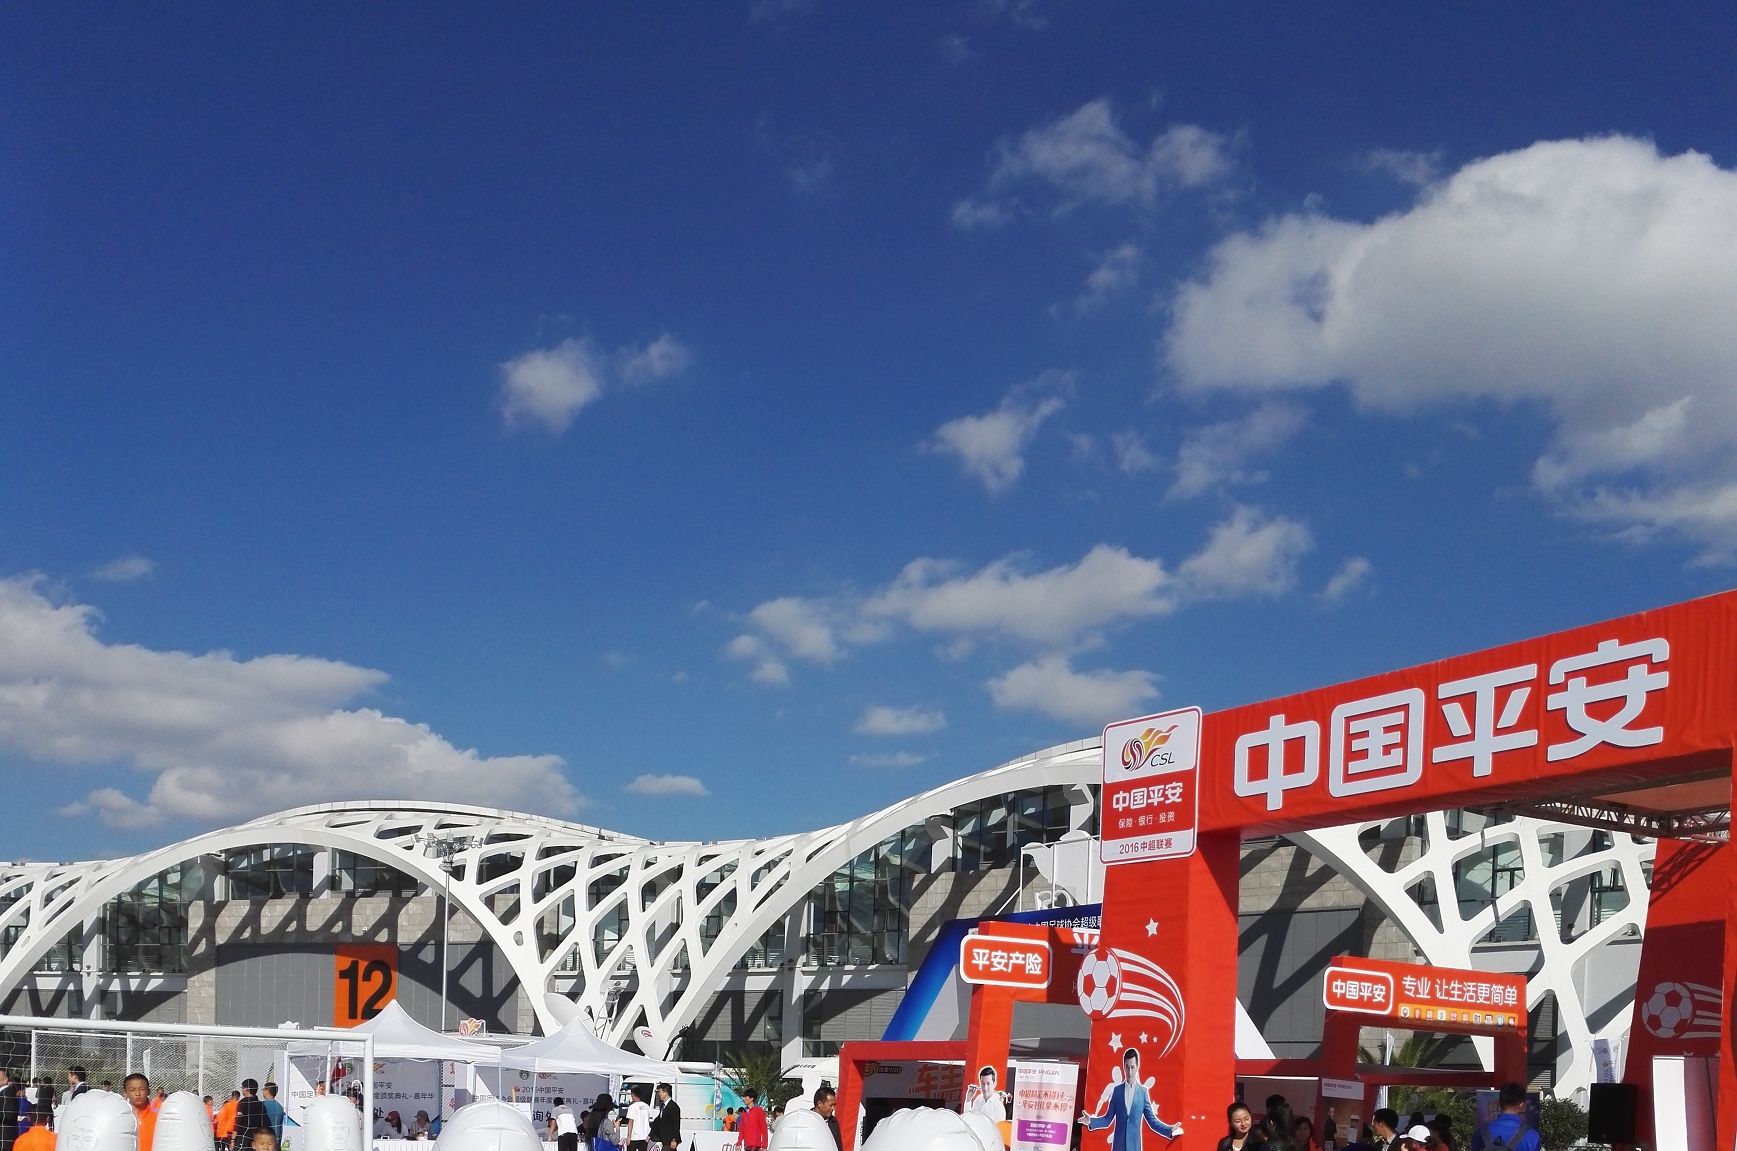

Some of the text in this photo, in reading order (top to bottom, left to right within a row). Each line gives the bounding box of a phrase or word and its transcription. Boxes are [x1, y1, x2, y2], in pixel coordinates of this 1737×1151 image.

[1233, 637, 1669, 811] 中国平安
[1150, 752, 1175, 767] CSL
[1112, 782, 1183, 812] 中国平安
[971, 948, 1043, 975] 平安产险
[339, 960, 393, 1020] 12
[1332, 979, 1386, 1003] 中国平安
[1401, 974, 1518, 1006] 专业 让生活更简单
